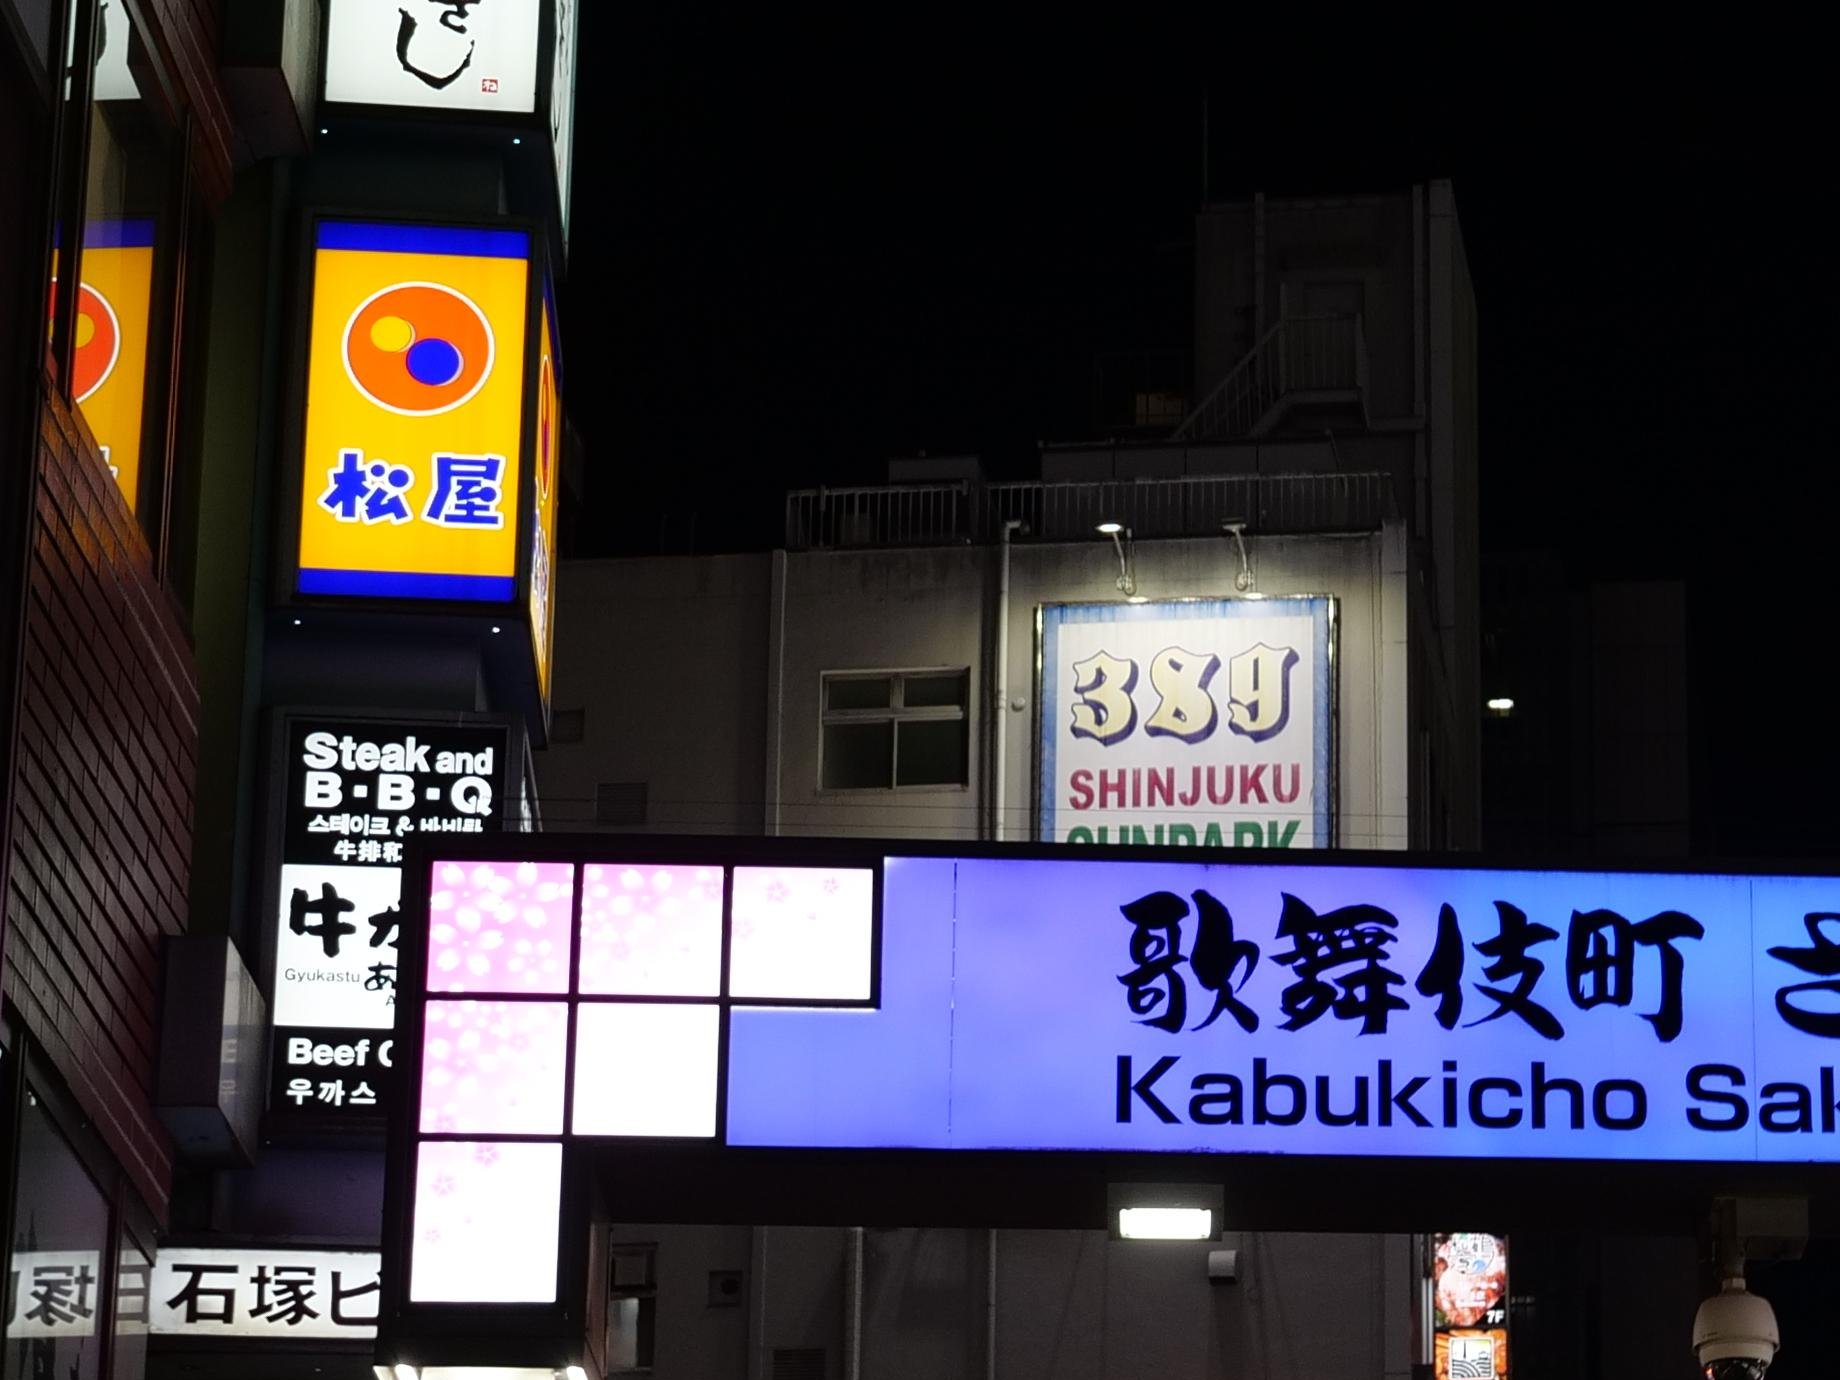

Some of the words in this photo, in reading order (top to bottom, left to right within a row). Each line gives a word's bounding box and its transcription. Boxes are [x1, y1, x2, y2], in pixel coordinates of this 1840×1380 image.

[318, 448, 506, 530] 松屋
[1071, 642, 1299, 747] 389
[303, 732, 431, 772] Steak
[436, 747, 493, 775] and
[1069, 763, 1301, 811] SHINJUKU
[307, 813, 391, 836] 스테이크
[285, 967, 360, 984] Gyukastu
[1116, 889, 1704, 1042] 歌舞伎町
[287, 1037, 369, 1067] Beef
[1115, 1055, 1648, 1130] Kabukicho
[1486, 1310, 1505, 1324] 7F
